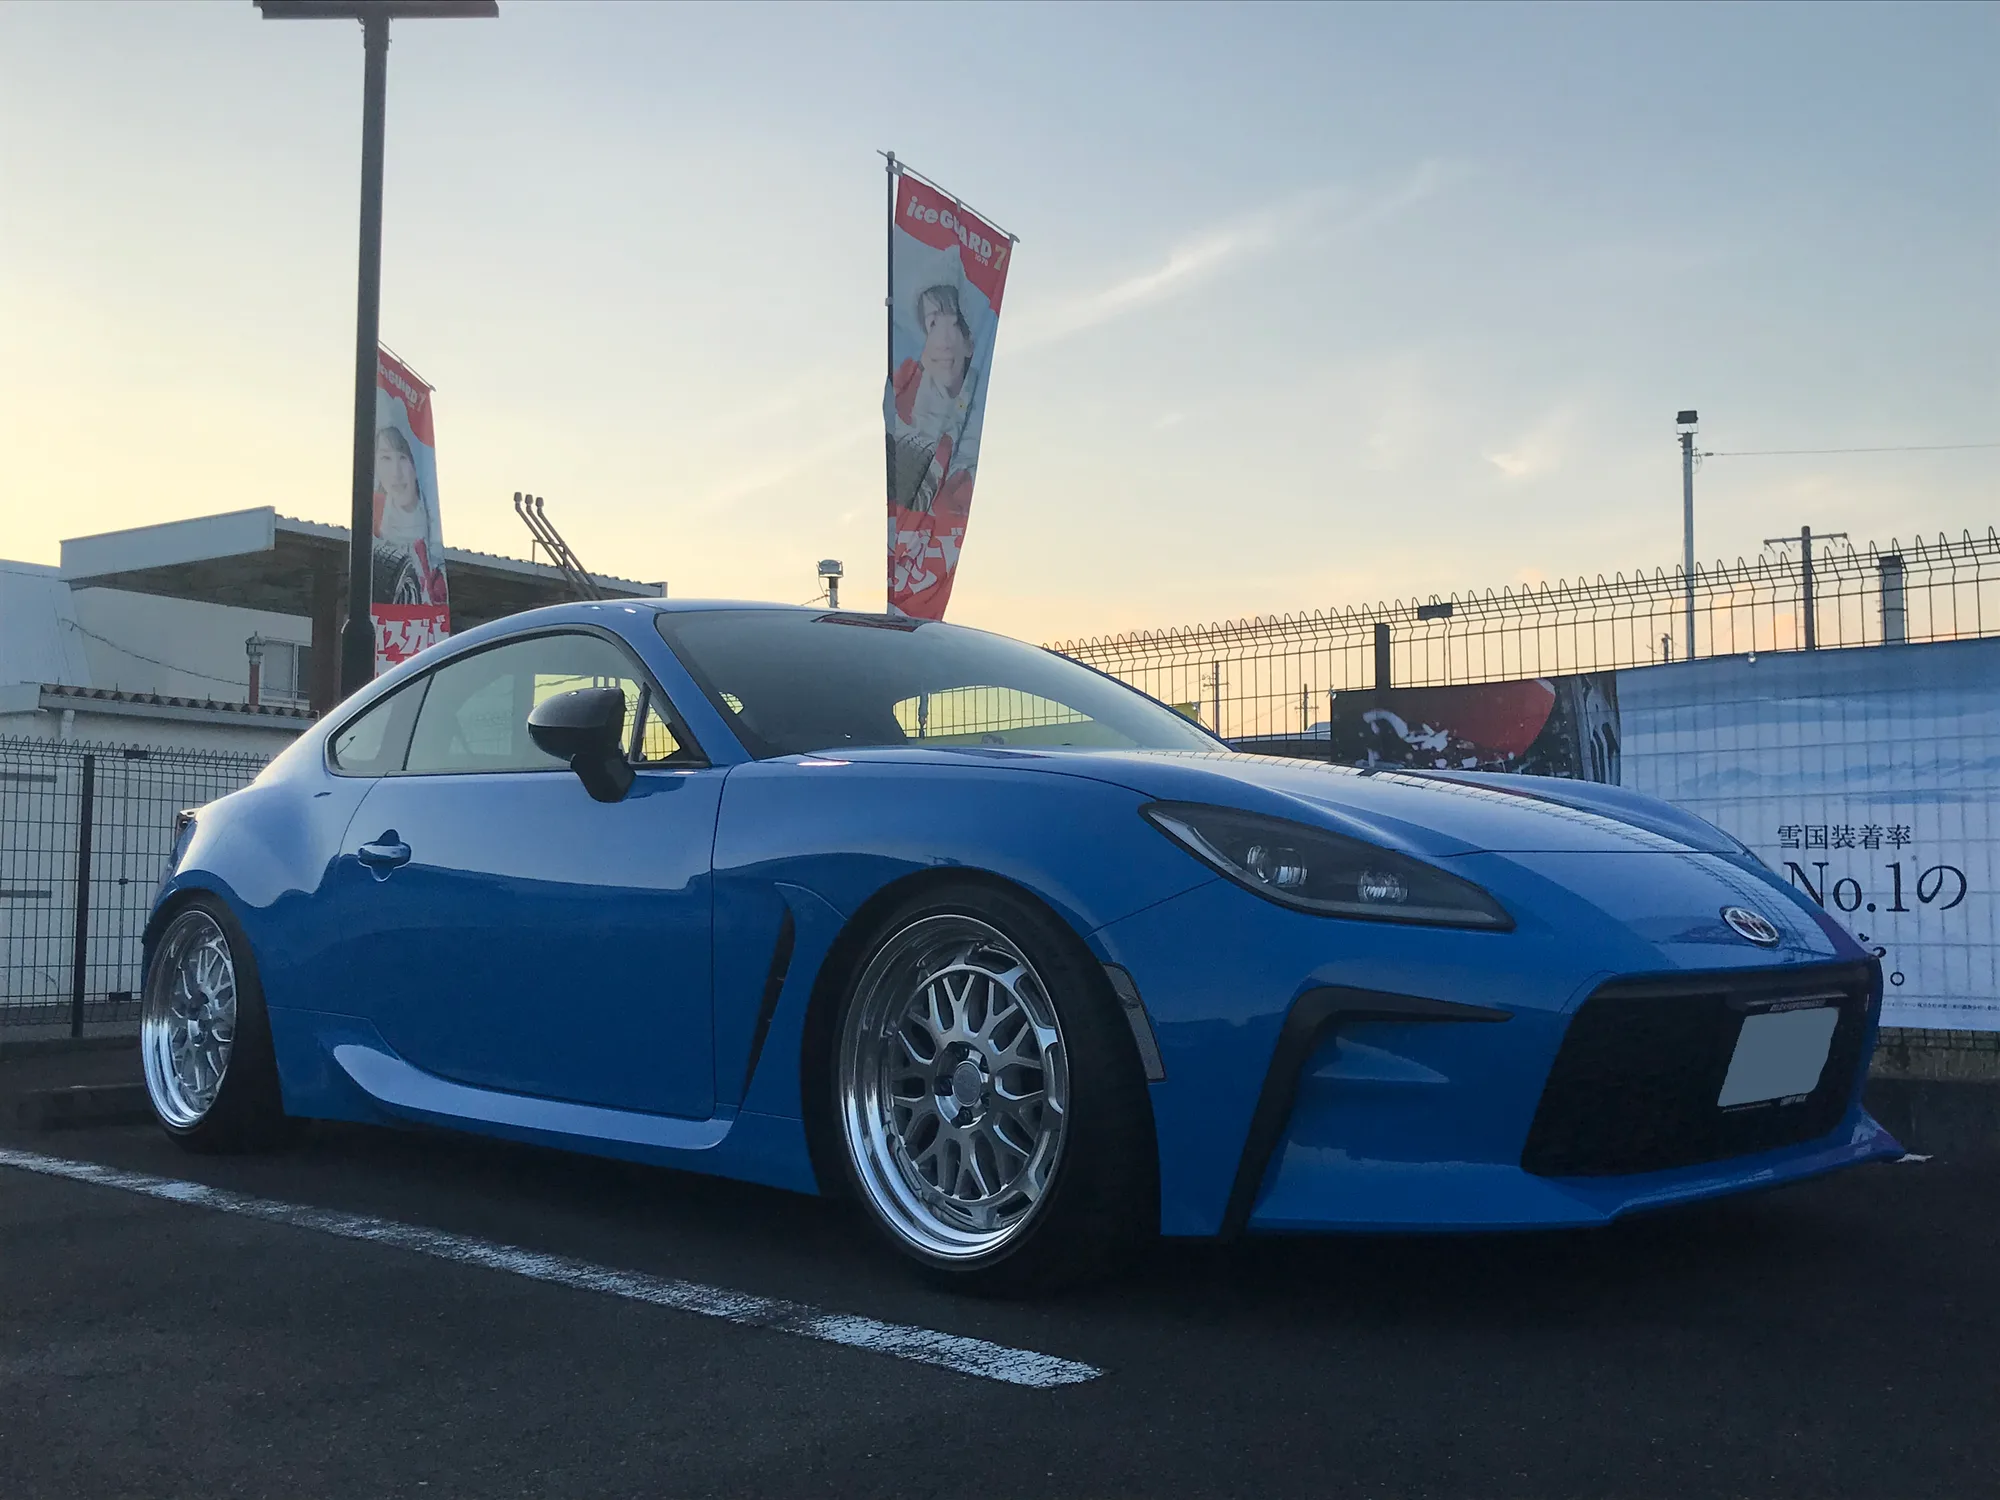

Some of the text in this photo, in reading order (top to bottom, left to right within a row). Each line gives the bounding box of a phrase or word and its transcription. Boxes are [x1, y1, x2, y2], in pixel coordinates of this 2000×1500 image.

[1777, 824, 1912, 850] 雪国装着率
[1783, 861, 1967, 912] No.1の
